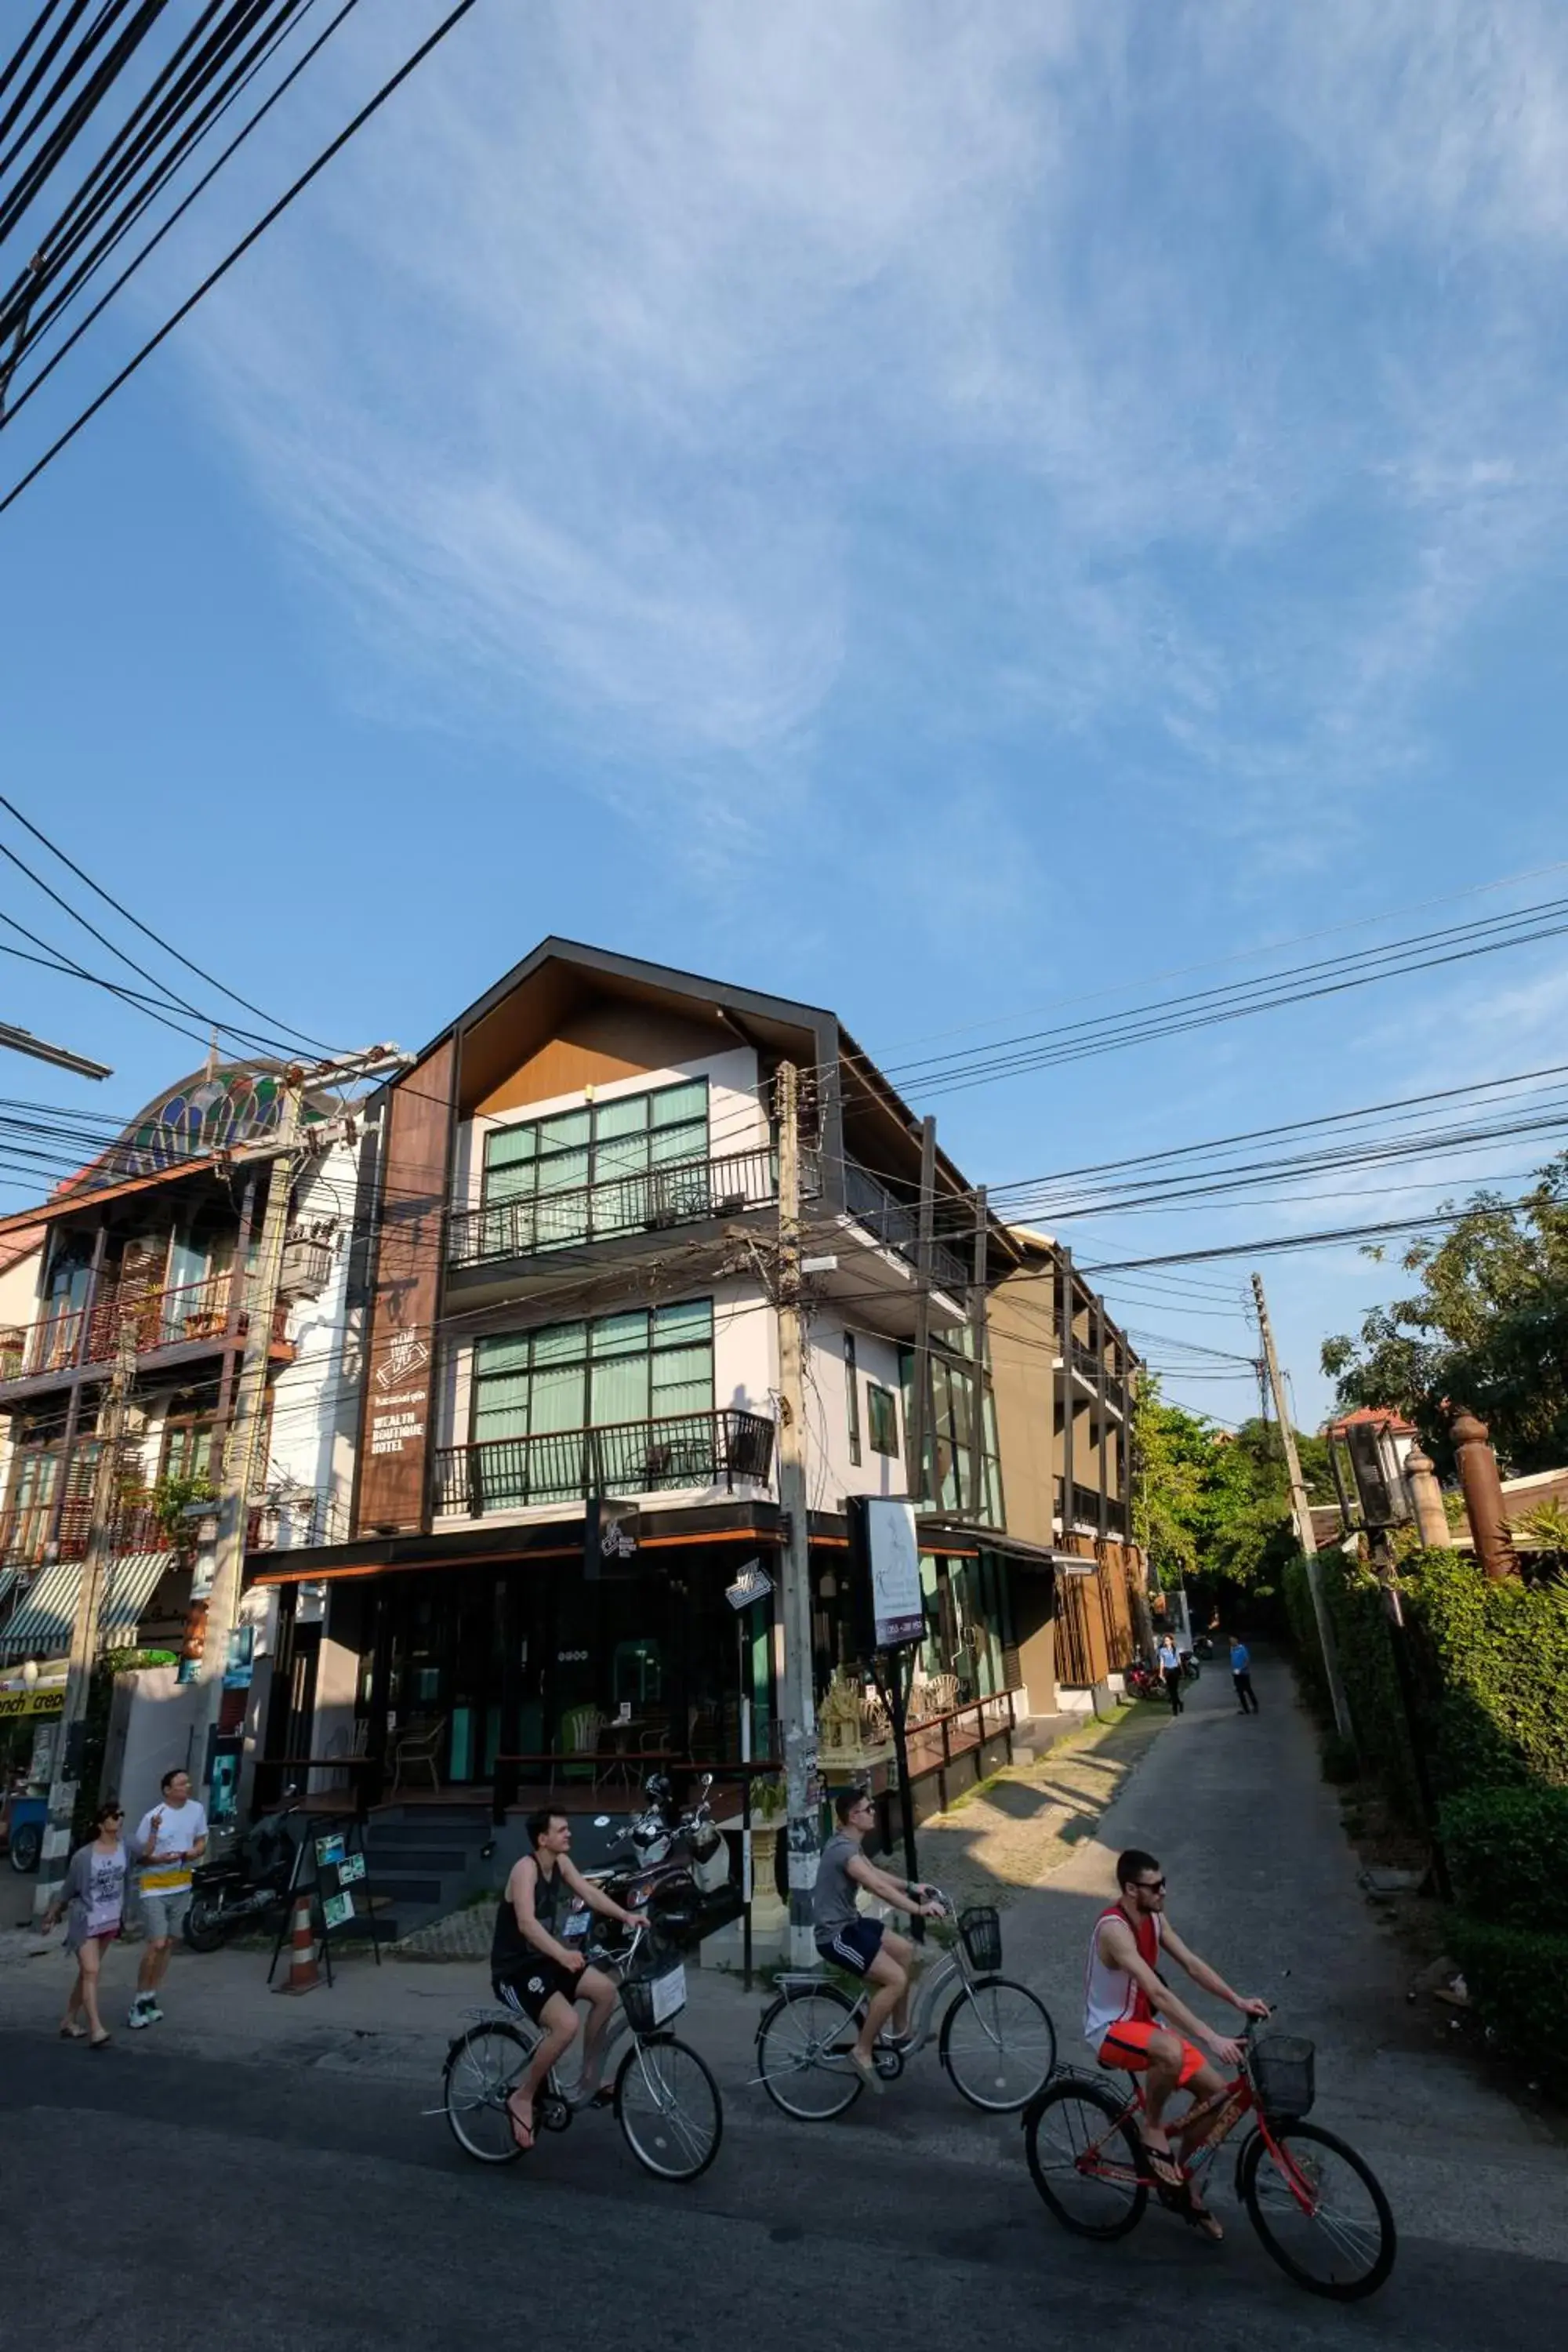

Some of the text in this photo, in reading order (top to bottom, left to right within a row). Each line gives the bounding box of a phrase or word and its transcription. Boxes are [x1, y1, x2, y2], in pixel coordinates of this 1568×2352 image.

[373, 1412, 415, 1428] WEALTH
[372, 1423, 424, 1442] BOUTIQUE
[371, 1439, 404, 1454] HOTEL
